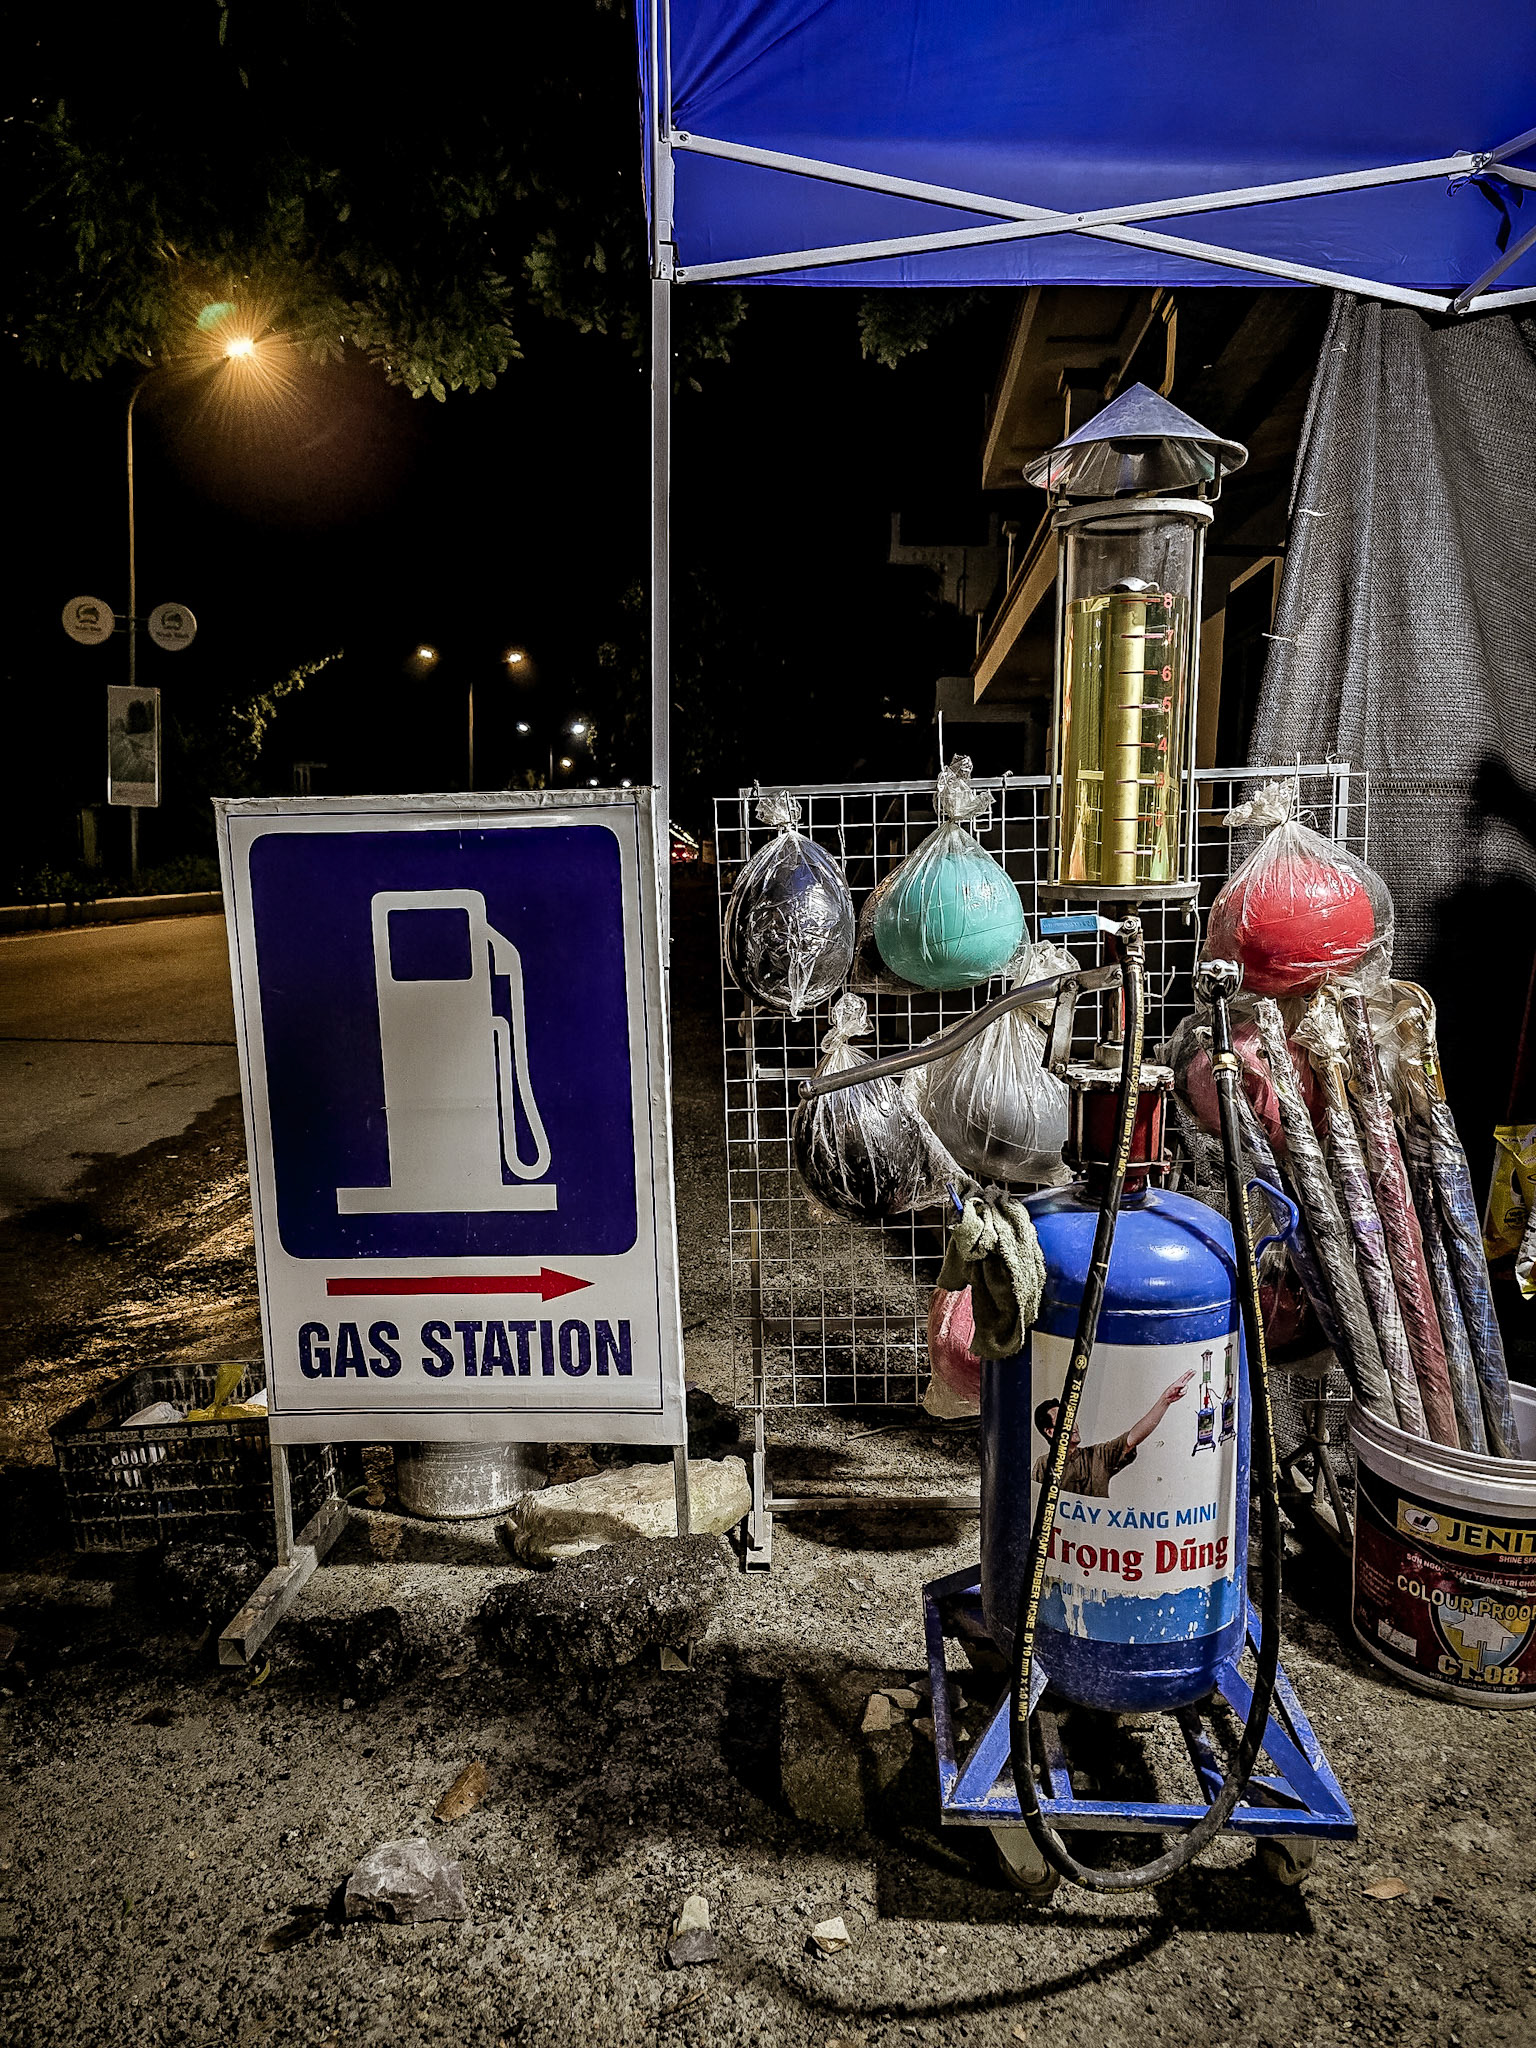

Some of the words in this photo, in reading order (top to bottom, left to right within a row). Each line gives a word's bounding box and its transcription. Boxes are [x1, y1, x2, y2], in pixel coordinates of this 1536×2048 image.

[1164, 592, 1172, 608] 8
[1166, 629, 1174, 644] 7
[1162, 665, 1172, 682] 6
[1162, 696, 1172, 713] 5
[1158, 737, 1167, 752] 4
[1156, 772, 1165, 788] 3
[1155, 811, 1165, 827] 2
[1132, 1029, 1144, 1067] RUBBER
[1129, 1066, 1140, 1094] HOSE
[1128, 1096, 1137, 1107] ID
[1126, 1108, 1135, 1118] 10
[1124, 1119, 1132, 1136] mm
[1117, 1158, 1127, 1177] MPa
[298, 1320, 402, 1379] GAS
[420, 1319, 633, 1378] STATION
[1072, 1379, 1082, 1391] 75
[1062, 1392, 1079, 1432] RUBBER
[1054, 1432, 1070, 1480] COMPANY
[1047, 1485, 1059, 1502] OIL
[1059, 1500, 1101, 1525] CÂY
[1107, 1506, 1169, 1529] XĂNG
[1175, 1502, 1217, 1528] MINI
[1038, 1502, 1056, 1557] RESISTANT
[1046, 1526, 1144, 1582] Trọng
[1155, 1536, 1229, 1575] Dũng
[1499, 1555, 1522, 1564] SHINE
[1030, 1557, 1046, 1600] RUBBER
[1397, 1574, 1473, 1614] COLOUR
[1026, 1600, 1039, 1629] HOSE
[1024, 1632, 1034, 1646] ID
[1023, 1646, 1033, 1657] 10
[1020, 1658, 1030, 1676] mm
[1018, 1700, 1028, 1722] MPa
